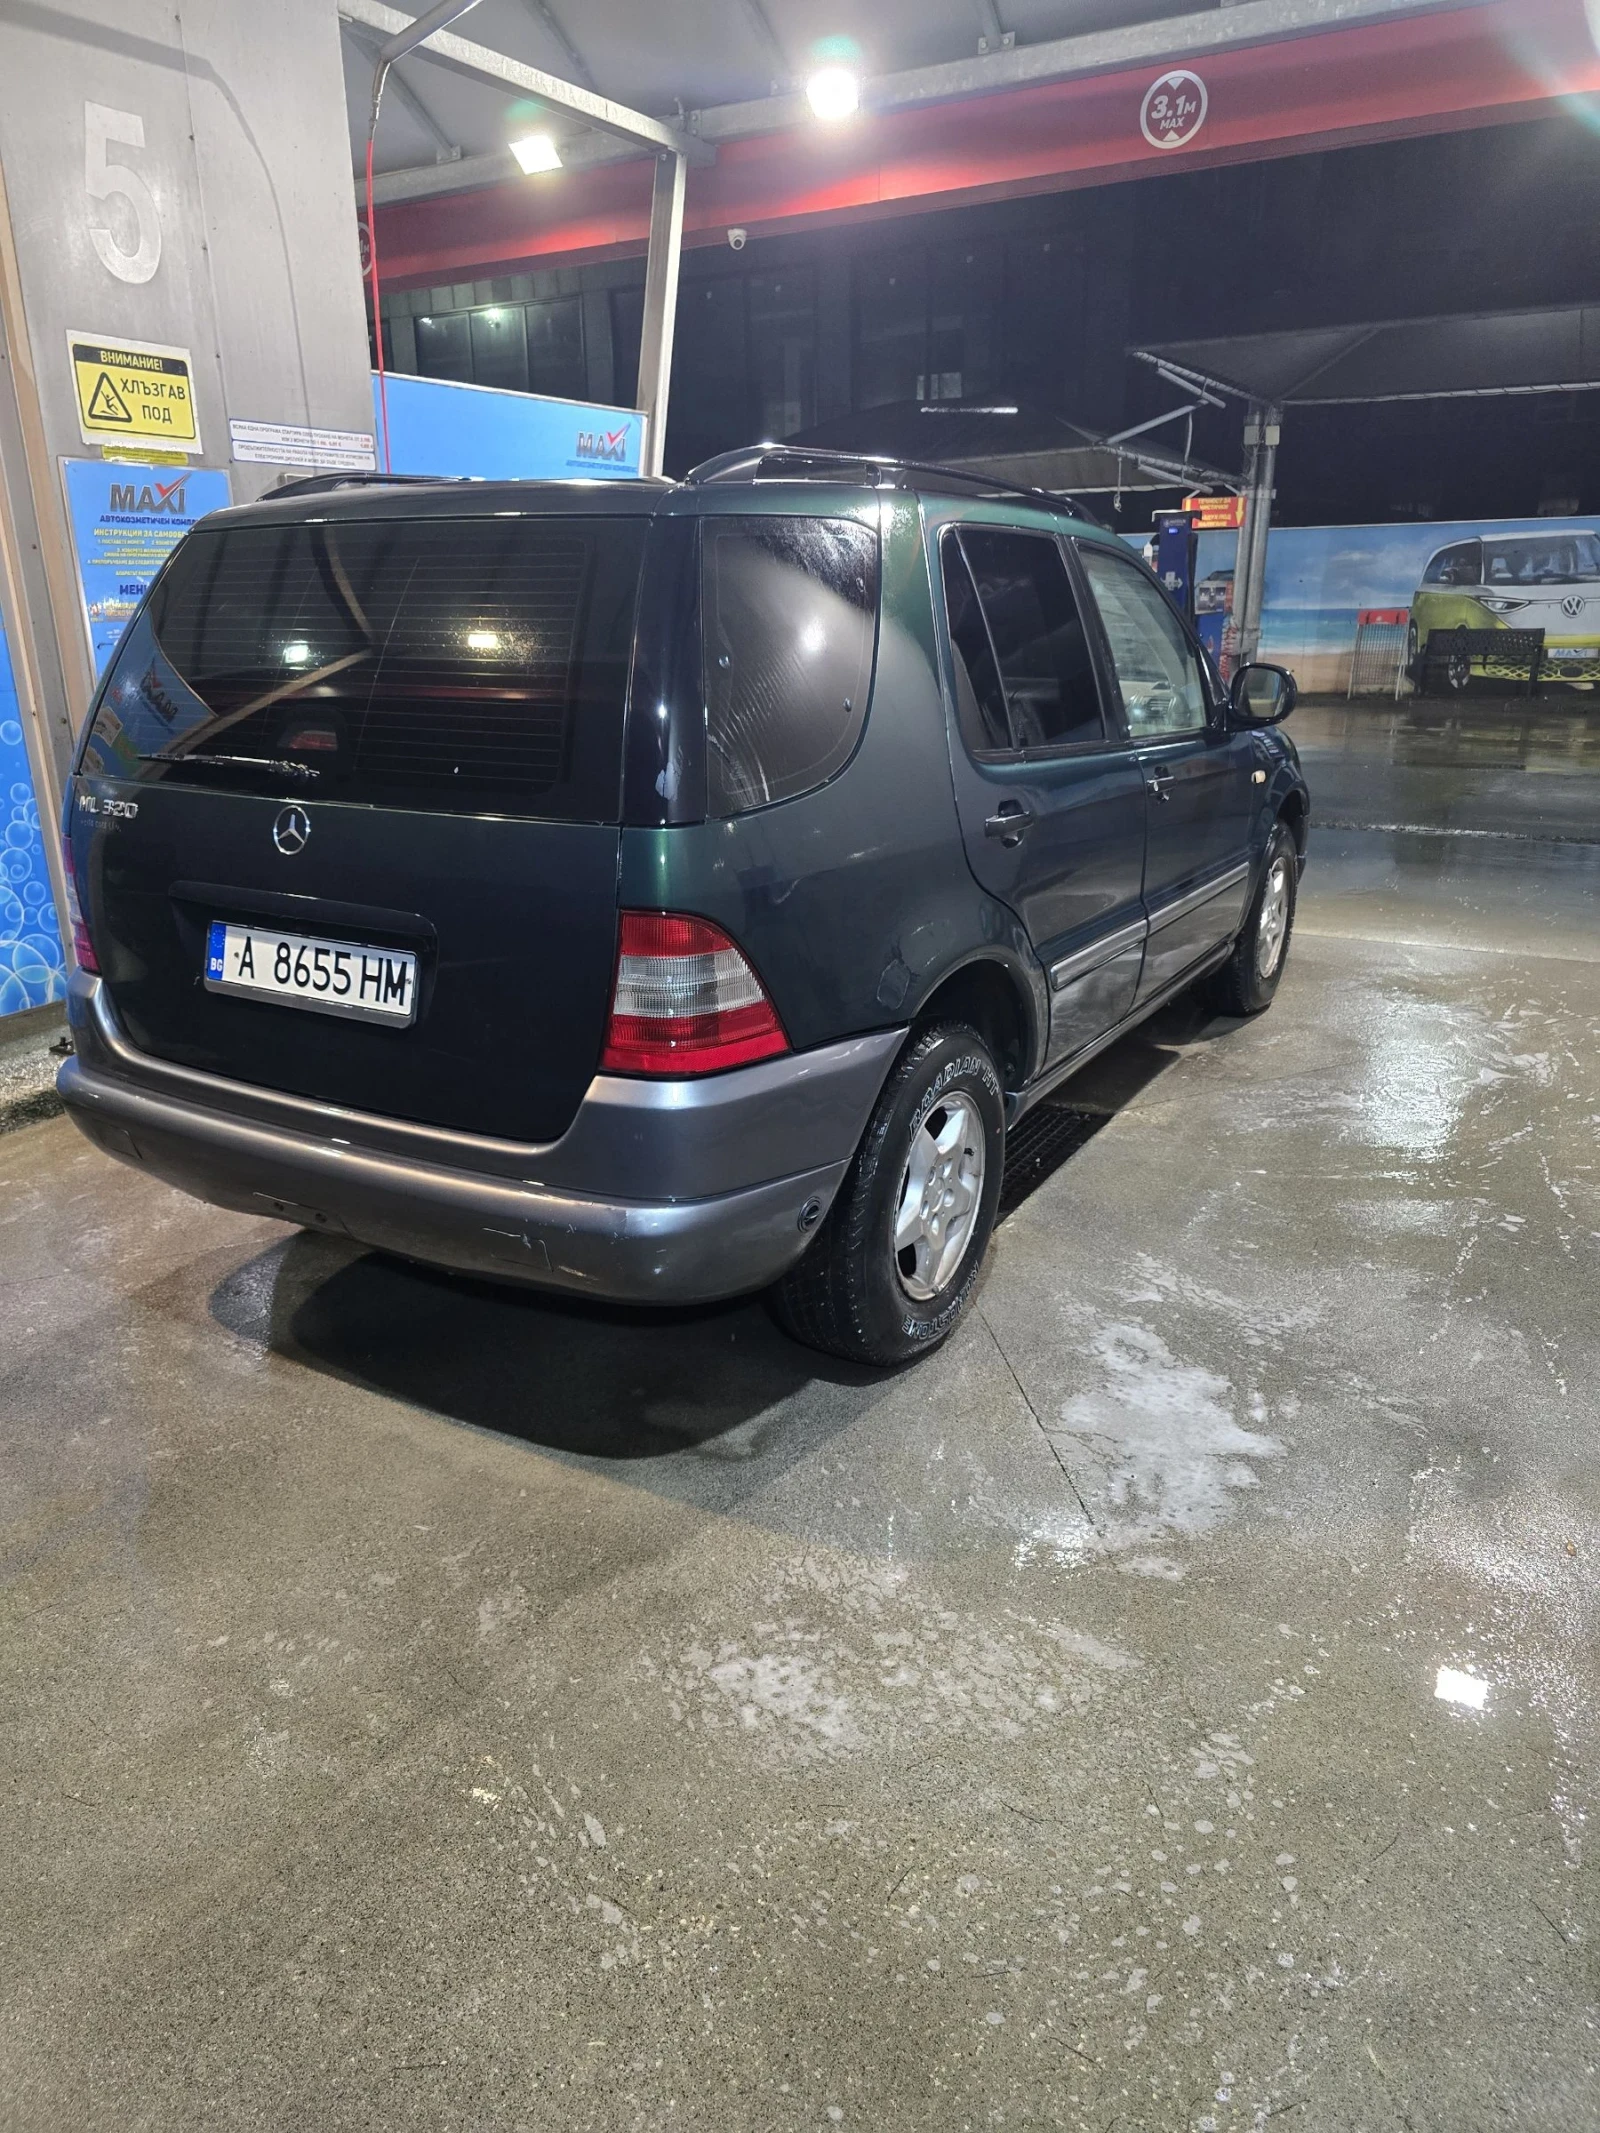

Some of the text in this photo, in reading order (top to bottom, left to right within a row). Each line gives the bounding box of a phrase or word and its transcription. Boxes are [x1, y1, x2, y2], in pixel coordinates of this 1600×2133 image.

[1160, 116, 1185, 130] MAX
[85, 100, 161, 284] 5
[100, 350, 163, 371] ВНИМАНИЕ!
[120, 378, 186, 400] ХЛЪЗГАВ
[142, 405, 173, 424] ПОД
[577, 422, 631, 462] MAXI
[110, 471, 191, 514] MAXI
[100, 515, 170, 524] АВТОКОЗМЕТИЧЕН
[94, 528, 142, 538] ИНСТРУКЦИИ
[144, 529, 153, 537] ЗА
[79, 795, 139, 819] ML 320
[210, 957, 223, 971] BG
[238, 936, 408, 1006] A 8655 HM
